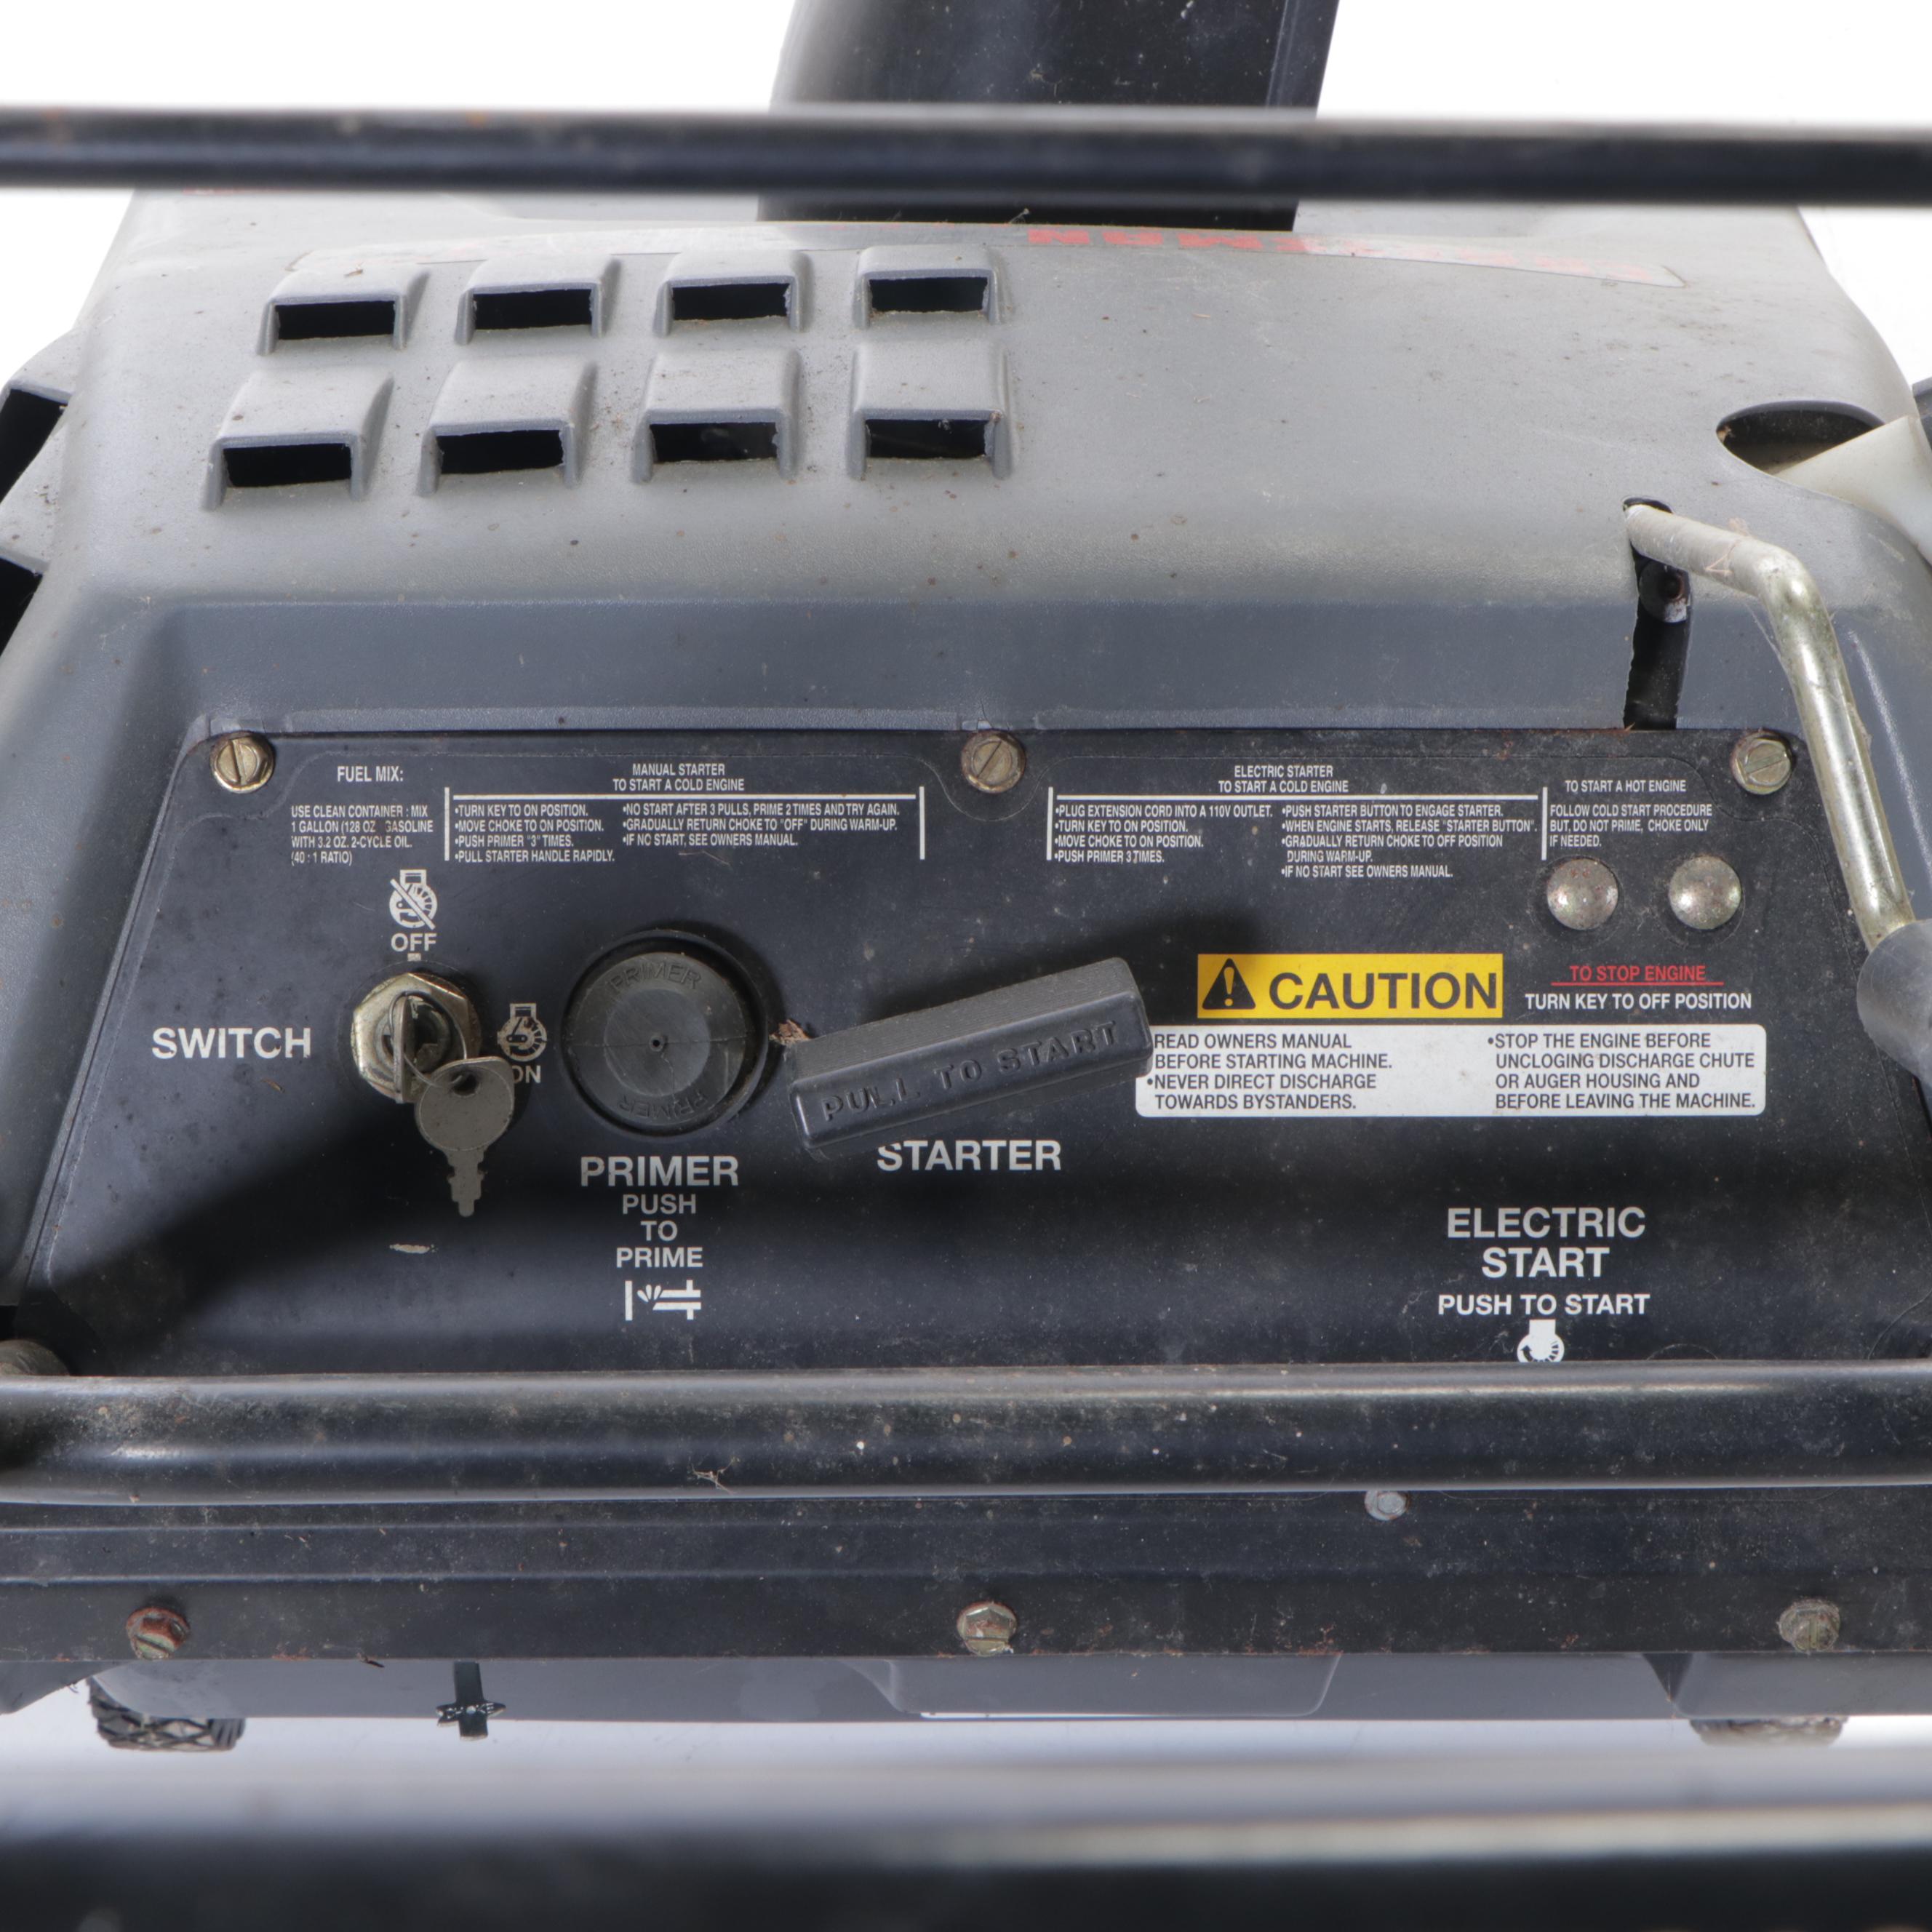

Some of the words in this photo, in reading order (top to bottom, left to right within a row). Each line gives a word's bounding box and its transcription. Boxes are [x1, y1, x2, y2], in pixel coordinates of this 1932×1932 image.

[338, 766, 372, 782] FUEL
[376, 766, 403, 781] MIX:
[633, 764, 676, 775] MANUAL
[679, 764, 724, 775] STARTER
[1234, 765, 1284, 778] ELECTRIC
[1288, 765, 1333, 778] STARTER
[613, 778, 626, 791] TO
[630, 778, 662, 791] START
[665, 779, 671, 791] A
[675, 778, 703, 791] COLD
[706, 778, 744, 791] ENGINE
[1218, 781, 1232, 793] TO
[1235, 781, 1266, 793] START
[1269, 781, 1277, 792] A
[1280, 781, 1307, 793] COLD
[1311, 781, 1348, 793] ENGINE
[1565, 780, 1578, 792] TO
[1581, 780, 1613, 792] START
[1616, 781, 1622, 791] A
[1626, 780, 1645, 792] HOT
[1649, 780, 1685, 792] ENGINE
[292, 805, 311, 818] USE
[314, 805, 345, 818] CLEAN
[348, 805, 402, 818] CONTAINER
[411, 805, 428, 817] MIX
[460, 805, 484, 817] TURN
[487, 805, 506, 816] KEY
[508, 805, 521, 816] TO
[524, 805, 538, 816] ON
[541, 804, 588, 816] POSITION.
[1061, 805, 1085, 817] PLUG
[1088, 805, 1141, 817] EXTENSION
[1145, 805, 1172, 817] CORD
[1175, 805, 1197, 817] INTO
[1199, 805, 1206, 817] A
[1210, 805, 1231, 817] 110V
[1234, 805, 1272, 817] OUTLET.
[1287, 805, 1312, 817] PUSH
[1314, 805, 1357, 817] STARTER
[1360, 805, 1398, 817] BUTTON
[1400, 805, 1413, 817] TO
[1416, 805, 1455, 817] ENGAGE
[1458, 805, 1503, 817] STARTER.
[1550, 805, 1589, 817] FOLLOW
[1592, 805, 1618, 817] COLD
[1621, 805, 1650, 816] START
[1653, 804, 1712, 816] PROCEDURE
[460, 820, 485, 832] MOVE
[489, 820, 522, 831] CHOKE
[524, 819, 537, 831] TO
[540, 819, 554, 831] ON
[556, 819, 603, 831] POSITION.
[628, 818, 684, 831] GRADUALLY
[687, 818, 726, 831] RETURN
[729, 818, 762, 831] CHOKE
[765, 818, 777, 831] TO
[810, 818, 847, 831] DURING
[850, 818, 897, 831] WARM-UP.
[1287, 820, 1314, 832] WHEN
[1317, 820, 1352, 832] ENGINE
[1355, 820, 1393, 832] STARTS,
[1396, 820, 1440, 831] RELEASE
[1550, 820, 1570, 832] BUT,
[1573, 820, 1587, 831] DO
[1590, 820, 1609, 831] NOT
[1612, 819, 1642, 831] PRIME,
[1648, 819, 1681, 831] CHOKE
[1684, 819, 1709, 831] ONLY
[292, 836, 315, 847] WITH
[318, 837, 331, 848] 3.2
[333, 836, 348, 848] OZ.
[351, 836, 391, 848] 2-CYCLE
[394, 836, 412, 848] OIL.
[460, 835, 484, 847] PUSH
[487, 835, 524, 847] PRIMER
[543, 834, 573, 847] TIMES.
[628, 834, 634, 845] IF
[637, 833, 651, 846] NO
[655, 834, 686, 846] START,
[689, 834, 707, 845] SEE
[711, 834, 752, 846] OWNERS
[755, 834, 797, 846] MANUAL.
[1550, 835, 1558, 847] IF
[1561, 835, 1601, 847] NEEDED.
[460, 850, 482, 863] PULL
[486, 850, 528, 862] STARTER
[532, 850, 570, 862] HANDLE
[573, 850, 614, 862] RAPIDLY.
[1059, 850, 1084, 862] PUSH
[1087, 850, 1123, 862] PRIMER
[1126, 850, 1131, 863] 3
[1133, 850, 1164, 863] TIMES.
[391, 933, 436, 951] OFF
[1570, 965, 1592, 982] TO
[1596, 966, 1641, 982] STOP
[1645, 965, 1705, 982] ENGINE
[1269, 972, 1496, 1010] CAUTION
[1525, 994, 1570, 1010] TURN
[1576, 994, 1608, 1009] KEY
[1612, 993, 1634, 1009] TO
[1639, 993, 1670, 1009] OFF
[1675, 993, 1751, 1009] POSITION
[152, 1027, 310, 1059] SWITCH
[1154, 1034, 1199, 1048] READ
[1205, 1034, 1277, 1048] OWNERS
[1282, 1034, 1352, 1048] MANUAL
[1496, 1034, 1538, 1048] STOP
[1544, 1034, 1574, 1047] THE
[1581, 1034, 1640, 1048] ENGINE
[1645, 1033, 1710, 1047] BEFORE
[933, 1059, 983, 1090] TO
[997, 1020, 1117, 1073] START
[1156, 1054, 1221, 1069] BEFORE
[1226, 1054, 1306, 1069] STARTING
[1312, 1054, 1392, 1069] MACHINE.
[1496, 1053, 1594, 1069] UNCLOGING
[1599, 1053, 1694, 1068] DISCHARGE
[1700, 1053, 1754, 1068] CHUTE
[1155, 1074, 1208, 1089] NEVER
[1215, 1074, 1274, 1089] DIRECT
[1280, 1074, 1376, 1089] DISCHARGE
[1496, 1074, 1519, 1088] OR
[1525, 1074, 1580, 1088] AUGER
[1586, 1074, 1660, 1088] HOUSING
[1666, 1074, 1699, 1087] AND
[1155, 1094, 1237, 1109] TOWARDS
[1244, 1094, 1356, 1109] BYSTANDERS.
[1496, 1094, 1560, 1109] BEFORE
[1566, 1093, 1634, 1109] LEAVING
[1640, 1093, 1670, 1108] THE
[1677, 1093, 1755, 1108] MACHINE.
[877, 1140, 1061, 1170] STARTER
[581, 1156, 738, 1186] PRIMER
[623, 1194, 695, 1214] PUSH
[1448, 1207, 1645, 1238] ELECTRIC
[641, 1221, 677, 1241] TO
[617, 1248, 703, 1268] PRIME
[1482, 1248, 1609, 1278] START
[1439, 1295, 1512, 1315] PUSH
[1520, 1294, 1557, 1315] TO
[1565, 1294, 1650, 1314] START
